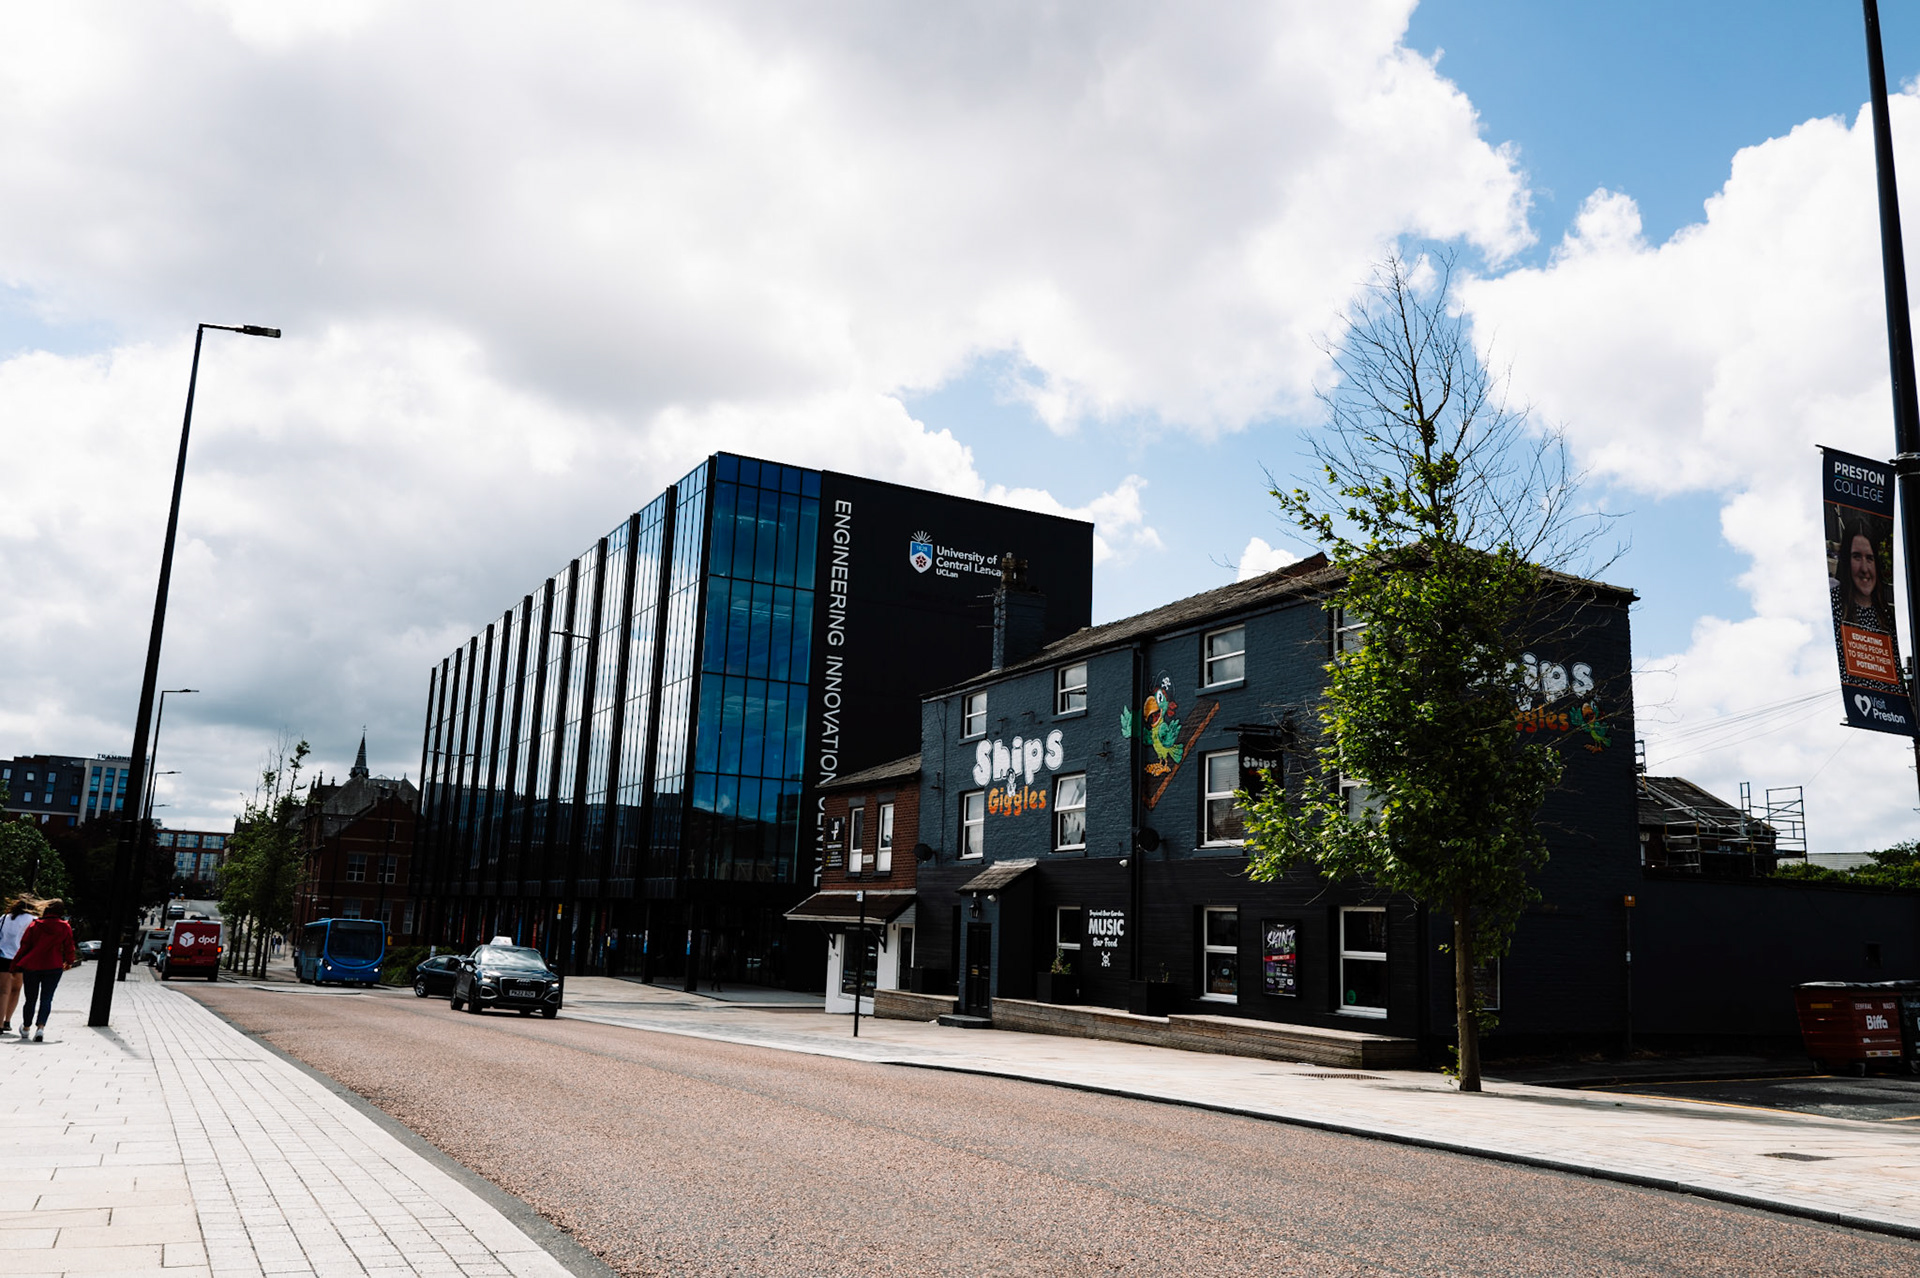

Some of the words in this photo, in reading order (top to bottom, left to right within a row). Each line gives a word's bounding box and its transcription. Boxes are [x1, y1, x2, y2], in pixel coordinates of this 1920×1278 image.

[1834, 461, 1885, 486] PRESTON
[1833, 479, 1884, 503] COLLEGE
[937, 545, 985, 566] University
[987, 554, 998, 565] of
[827, 499, 852, 646] ENGINEERING
[936, 558, 972, 573] Central
[936, 568, 959, 579] UCLan
[1852, 633, 1883, 646] EDUCATING
[1848, 641, 1868, 651] YOUNG
[1868, 646, 1889, 657] PEOPLE
[1848, 650, 1856, 658] TO
[1857, 652, 1875, 661] REACH
[1876, 656, 1891, 666] THEIR
[1856, 660, 1887, 673] POTENTIAL
[1870, 696, 1886, 710] Visit
[1872, 708, 1906, 724] Preston
[973, 729, 1064, 787] Ships
[1242, 755, 1278, 769] Ships
[988, 785, 1047, 816] Giggles
[1088, 918, 1125, 937] MUSIC
[198, 935, 216, 945] dpd
[1092, 937, 1104, 947] Bar
[1104, 937, 1118, 948] Food
[1266, 929, 1296, 948] SKINT
[1854, 1002, 1872, 1010] GENERAL
[1882, 1002, 1895, 1010] WASTE
[1866, 1014, 1888, 1030] Biffa
